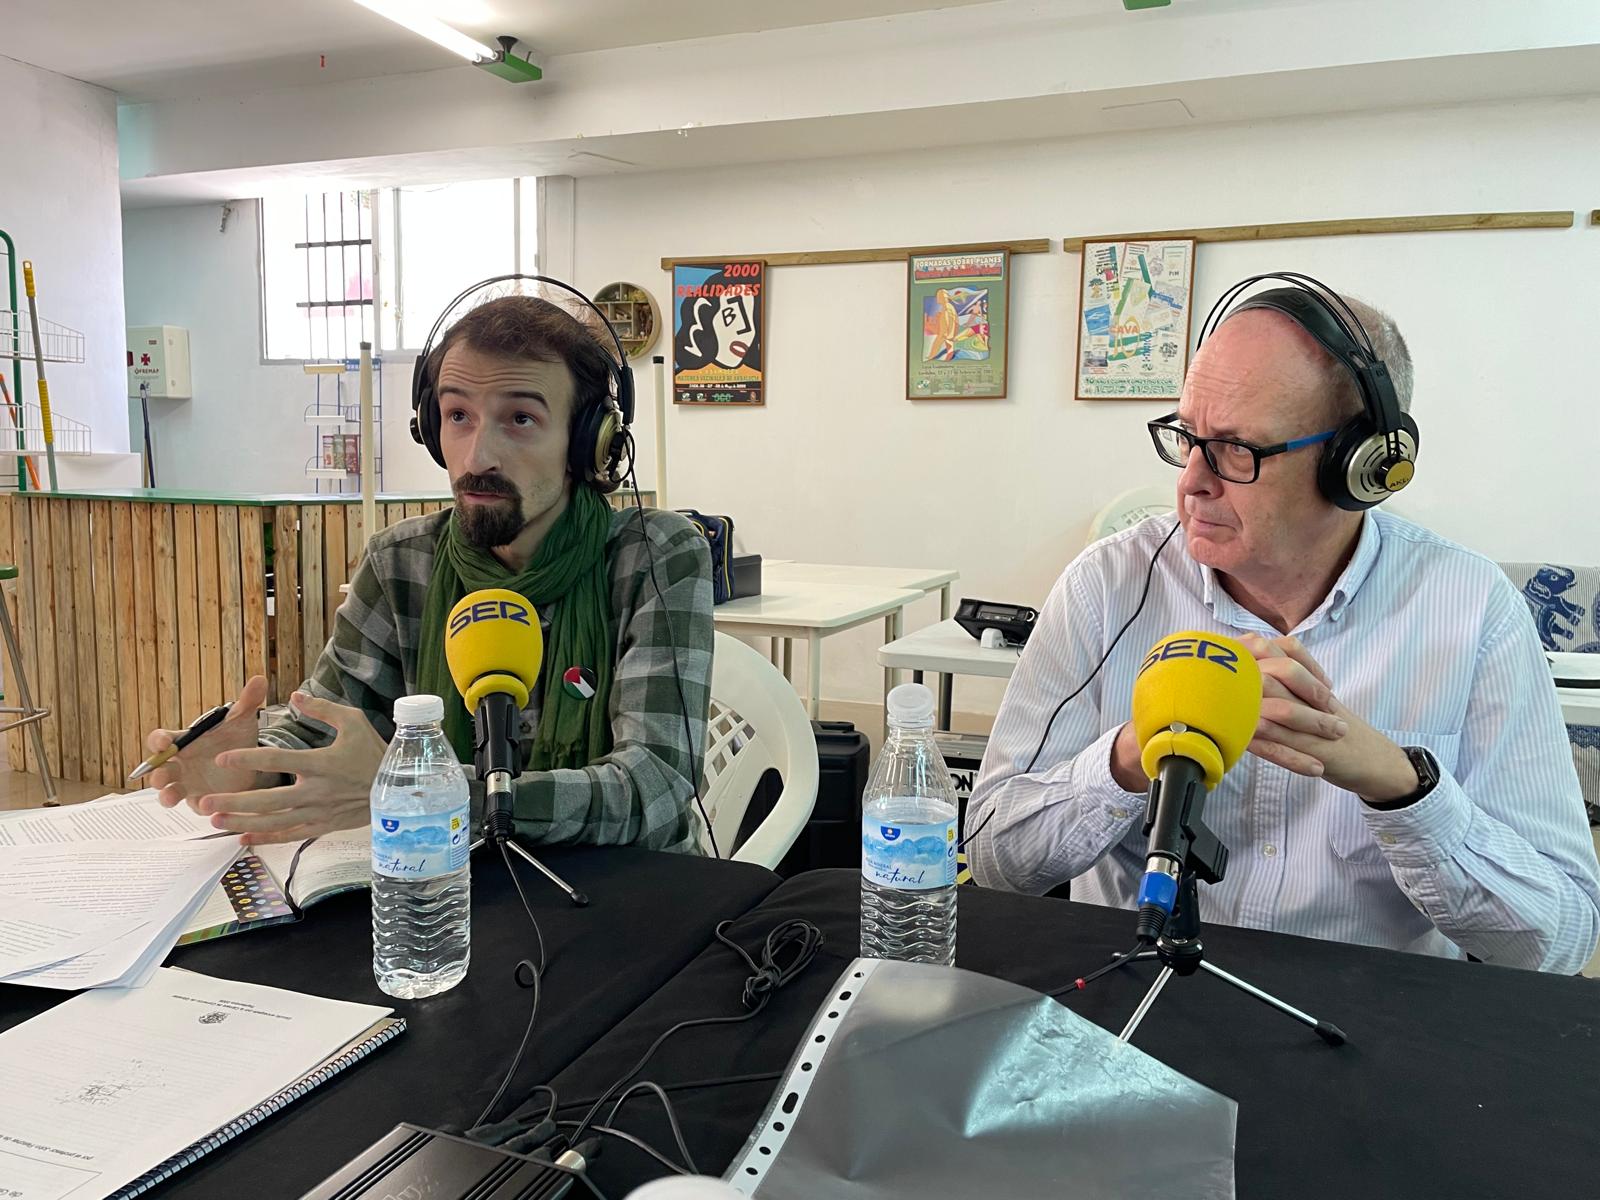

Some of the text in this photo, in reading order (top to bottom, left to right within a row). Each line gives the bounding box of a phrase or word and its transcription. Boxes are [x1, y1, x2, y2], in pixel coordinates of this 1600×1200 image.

[916, 260, 951, 268] JORNADAS
[976, 256, 1002, 264] PLANES
[724, 264, 760, 277] 2000
[677, 284, 761, 297] REALIDADES
[450, 601, 530, 639] SER
[1137, 639, 1238, 680] SER
[379, 858, 426, 873] natural
[875, 868, 925, 884] natural
